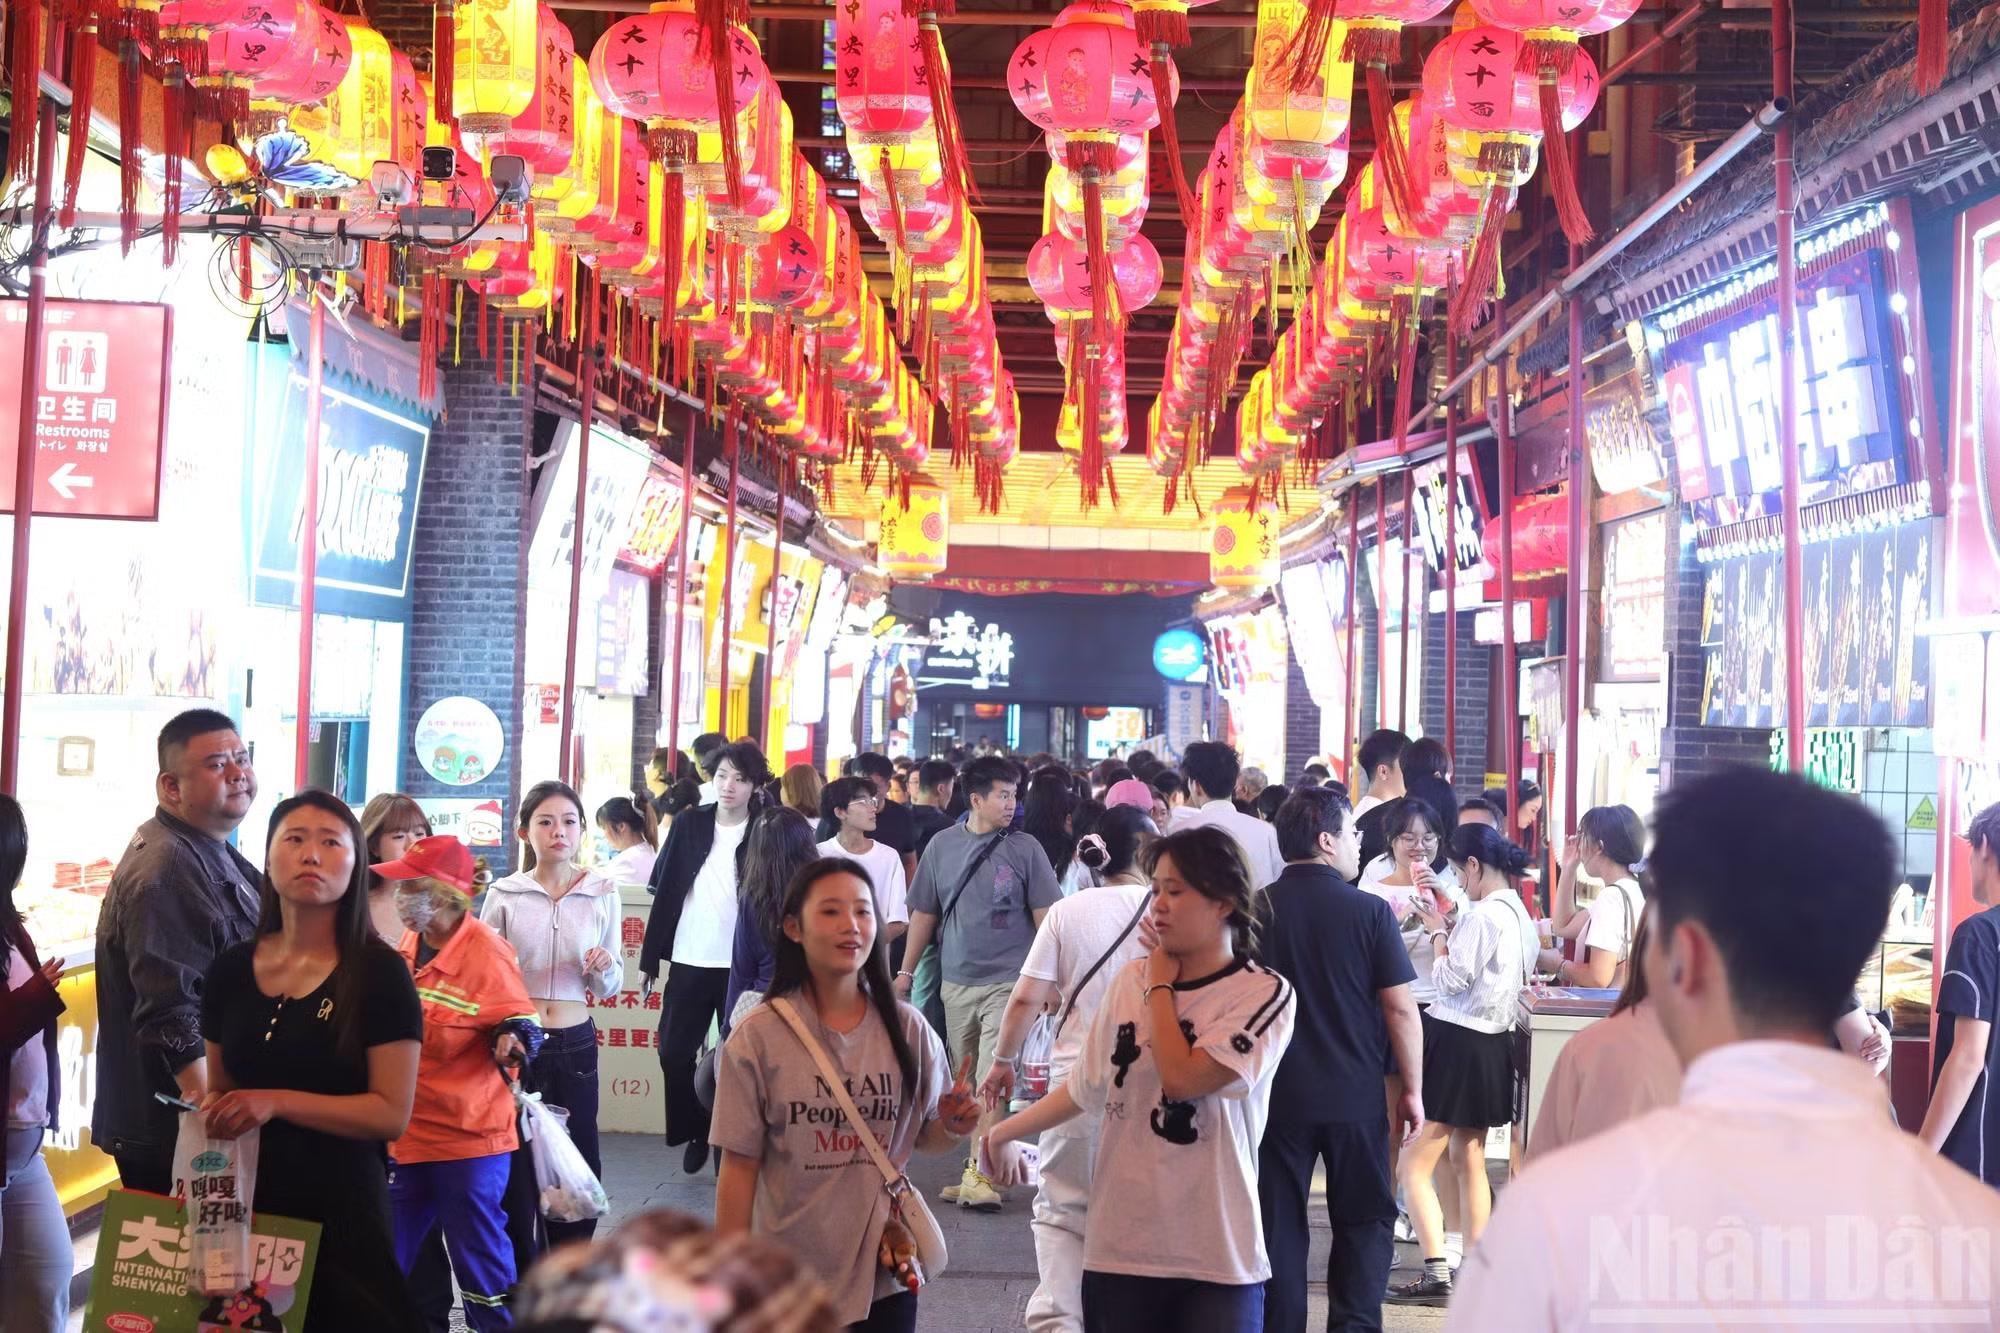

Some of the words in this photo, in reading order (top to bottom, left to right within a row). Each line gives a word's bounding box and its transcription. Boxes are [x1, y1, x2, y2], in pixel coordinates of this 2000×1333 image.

[842, 0, 863, 87] 中央里
[1466, 36, 1501, 118] 大十面
[37, 396, 118, 424] 卫生间
[36, 423, 111, 439] Restrooms
[39, 440, 67, 451] トイレ
[76, 440, 108, 453] 화장실
[612, 1078, 650, 1097] (12)
[815, 1074, 856, 1099] Nt
[860, 1073, 893, 1097] All
[789, 1101, 869, 1129] Peope
[814, 1129, 889, 1153] Moy.
[116, 1215, 306, 1286] 大阳
[111, 1274, 188, 1297] SHENYANG
